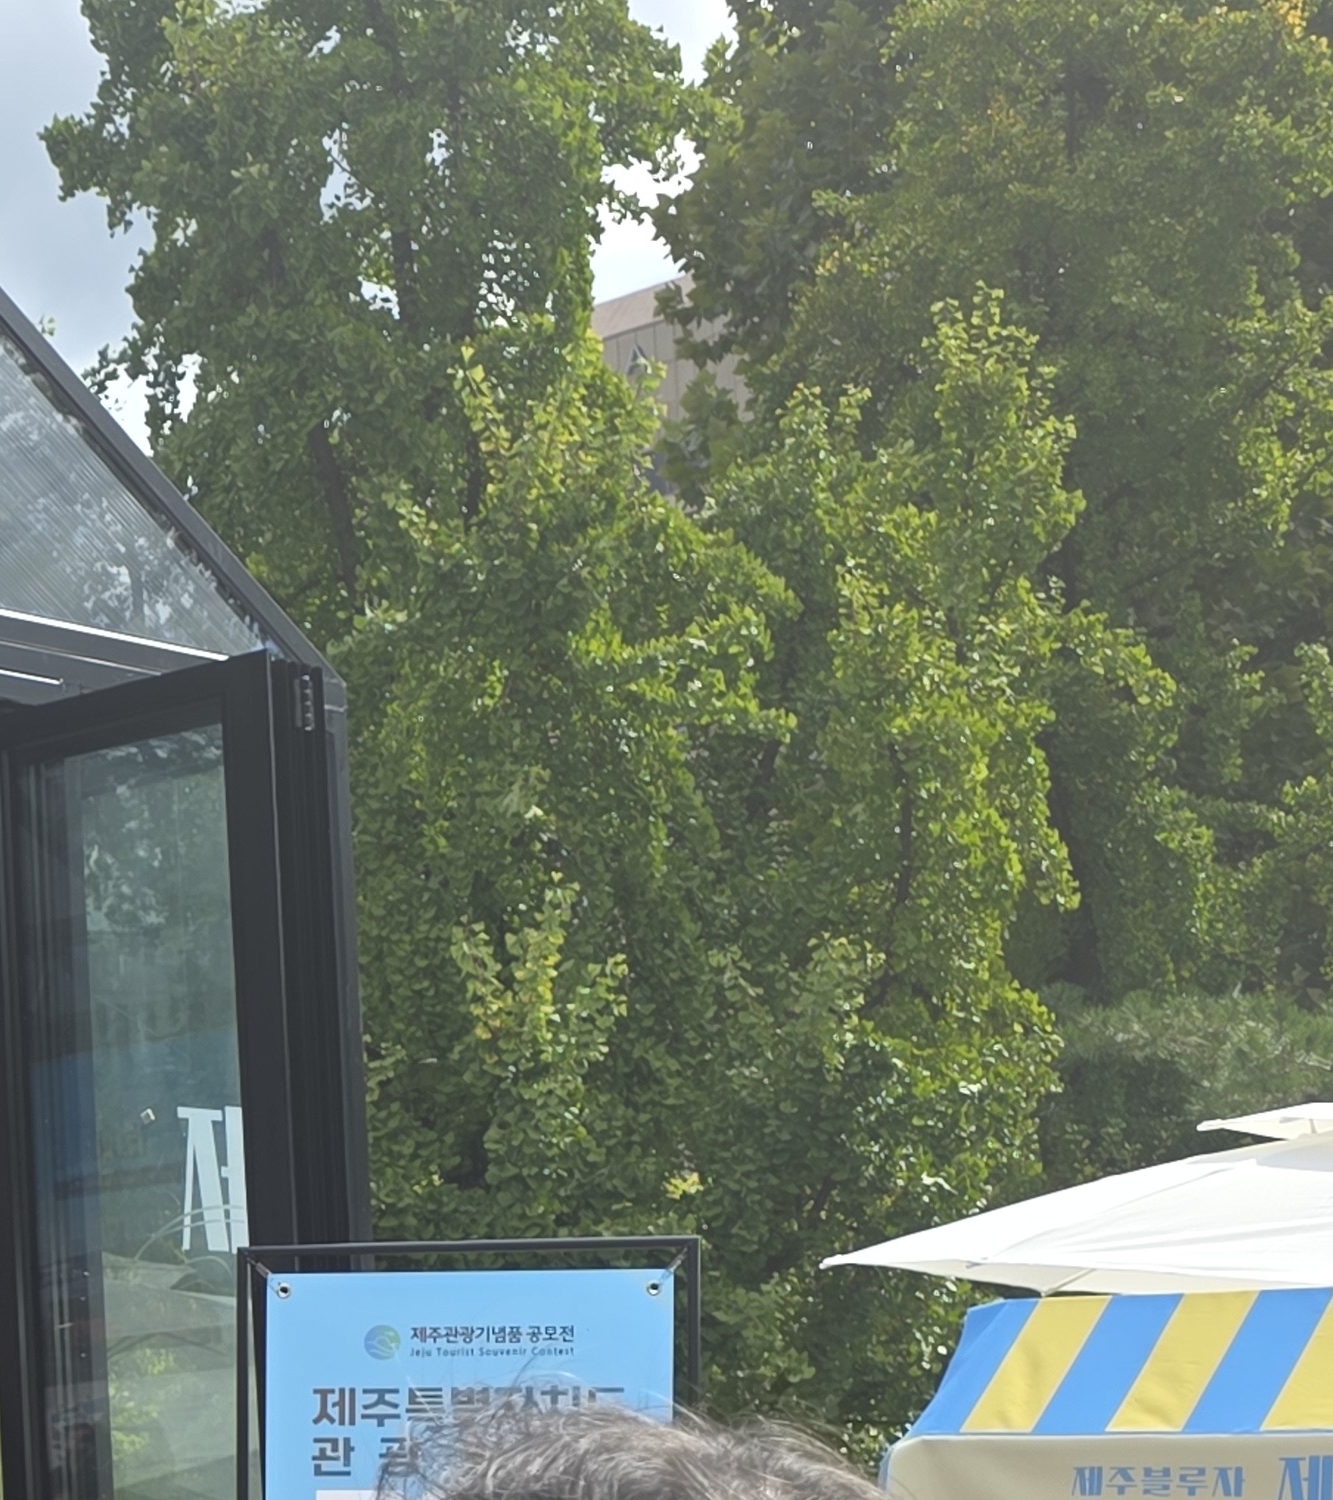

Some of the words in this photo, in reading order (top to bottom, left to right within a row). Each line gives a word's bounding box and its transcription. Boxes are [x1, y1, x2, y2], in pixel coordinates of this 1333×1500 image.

[410, 1324, 523, 1345] 제주관광기념품
[526, 1324, 575, 1344] 공모전
[437, 1346, 475, 1357] Tourist
[1071, 1466, 1245, 1498] 제주블루자
